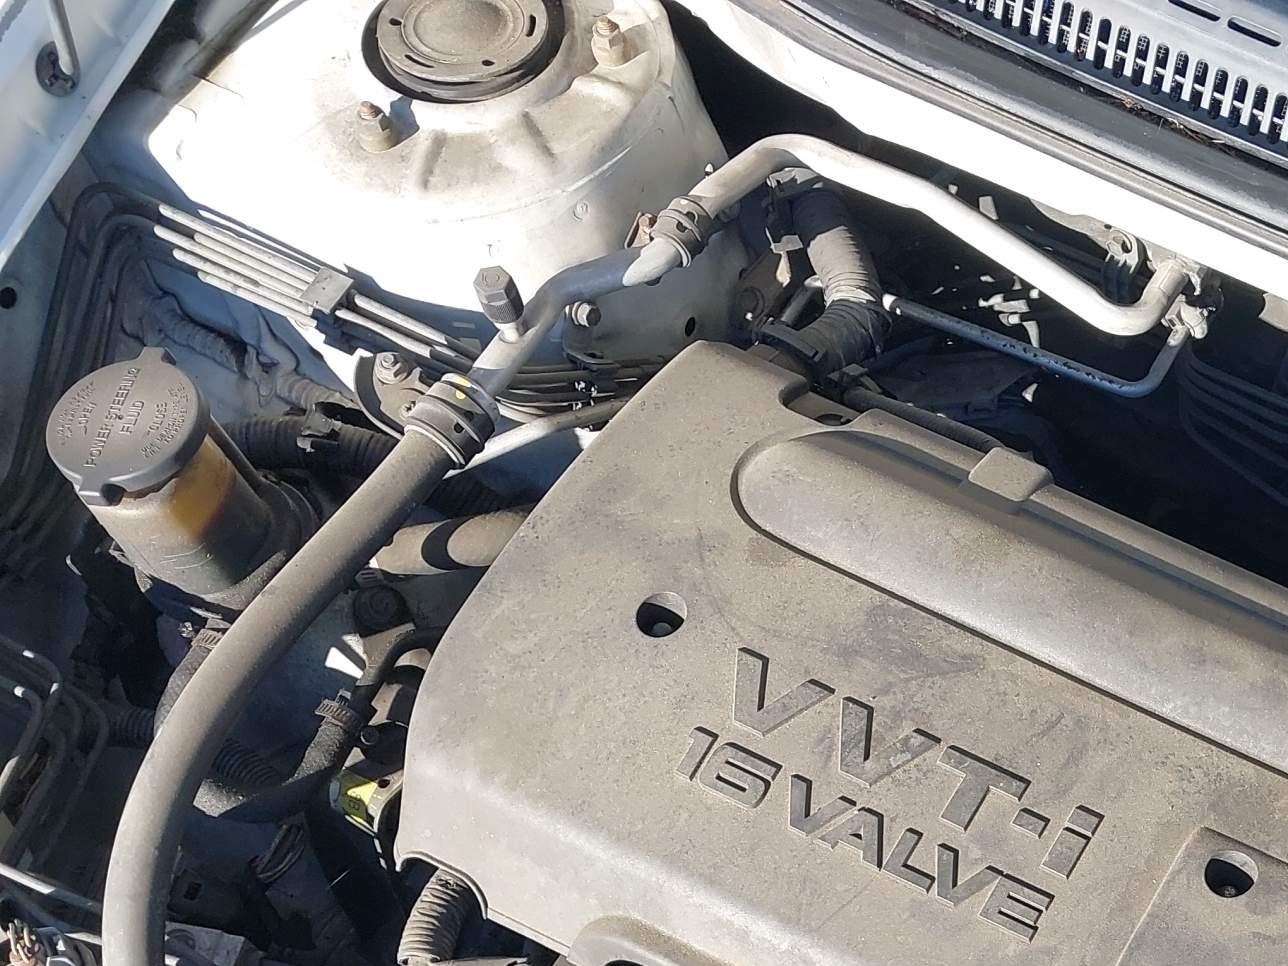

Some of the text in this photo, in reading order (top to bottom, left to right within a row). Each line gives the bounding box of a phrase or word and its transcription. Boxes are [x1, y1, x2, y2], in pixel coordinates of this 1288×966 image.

[83, 367, 141, 468] POWER STEERING
[119, 400, 145, 434] FLUID
[674, 725, 1055, 944] 16 VALVE
[732, 645, 1105, 880] VVT-i
